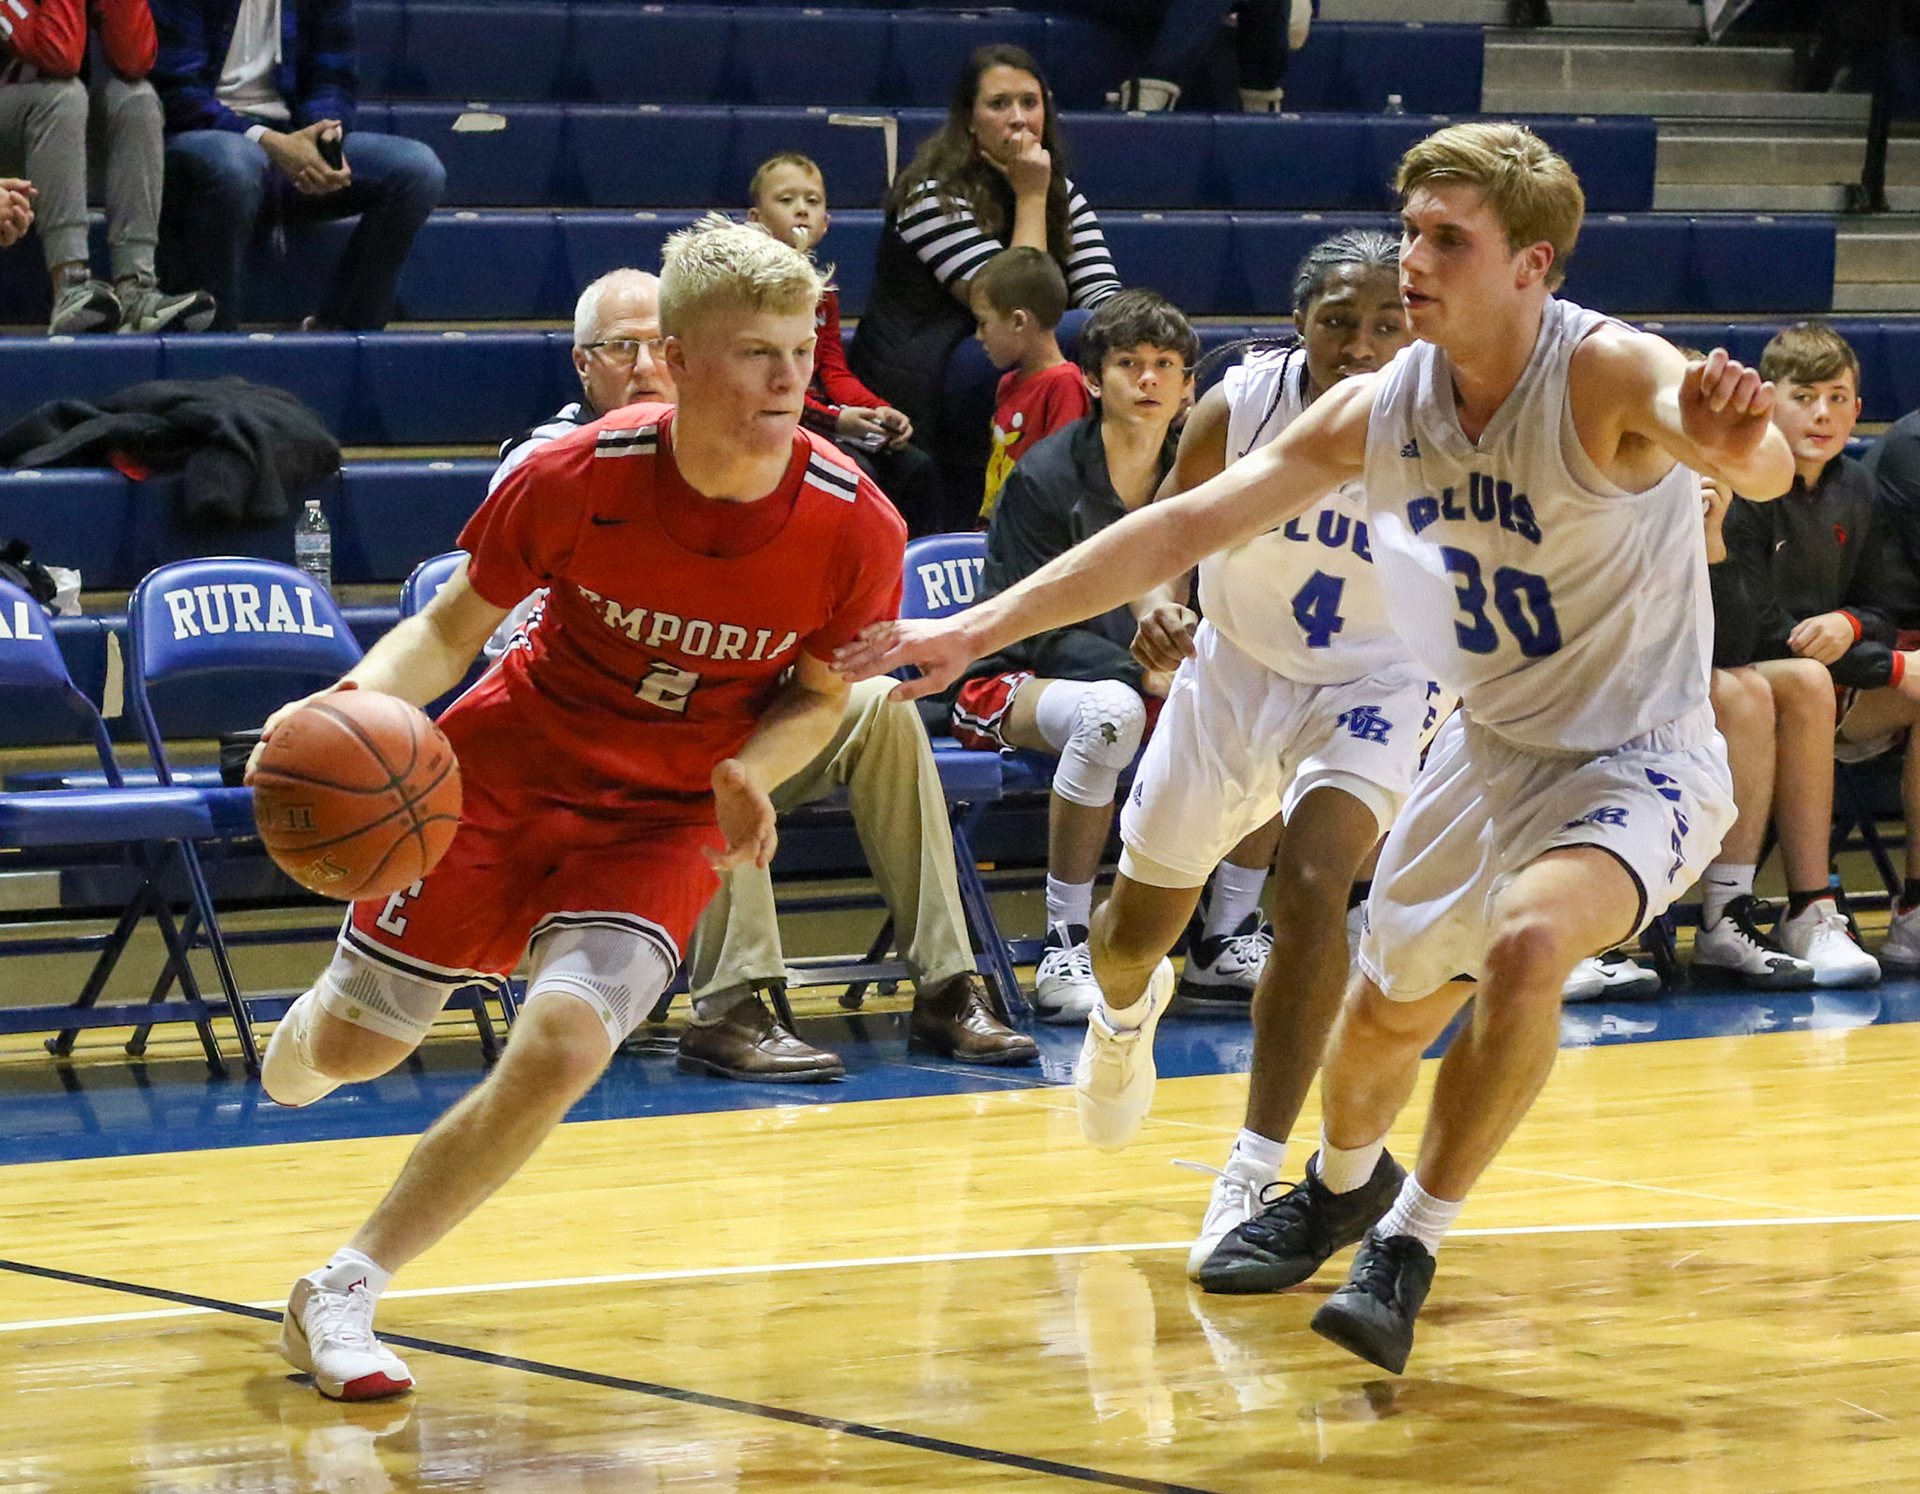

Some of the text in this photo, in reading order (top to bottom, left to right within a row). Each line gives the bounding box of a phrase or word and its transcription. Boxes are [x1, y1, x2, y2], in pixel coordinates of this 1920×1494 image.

[1260, 509, 1374, 565] LUE
[163, 583, 335, 642] RURAL
[1290, 568, 1347, 648] 4
[1438, 545, 1564, 658] 30
[632, 658, 701, 716] 2
